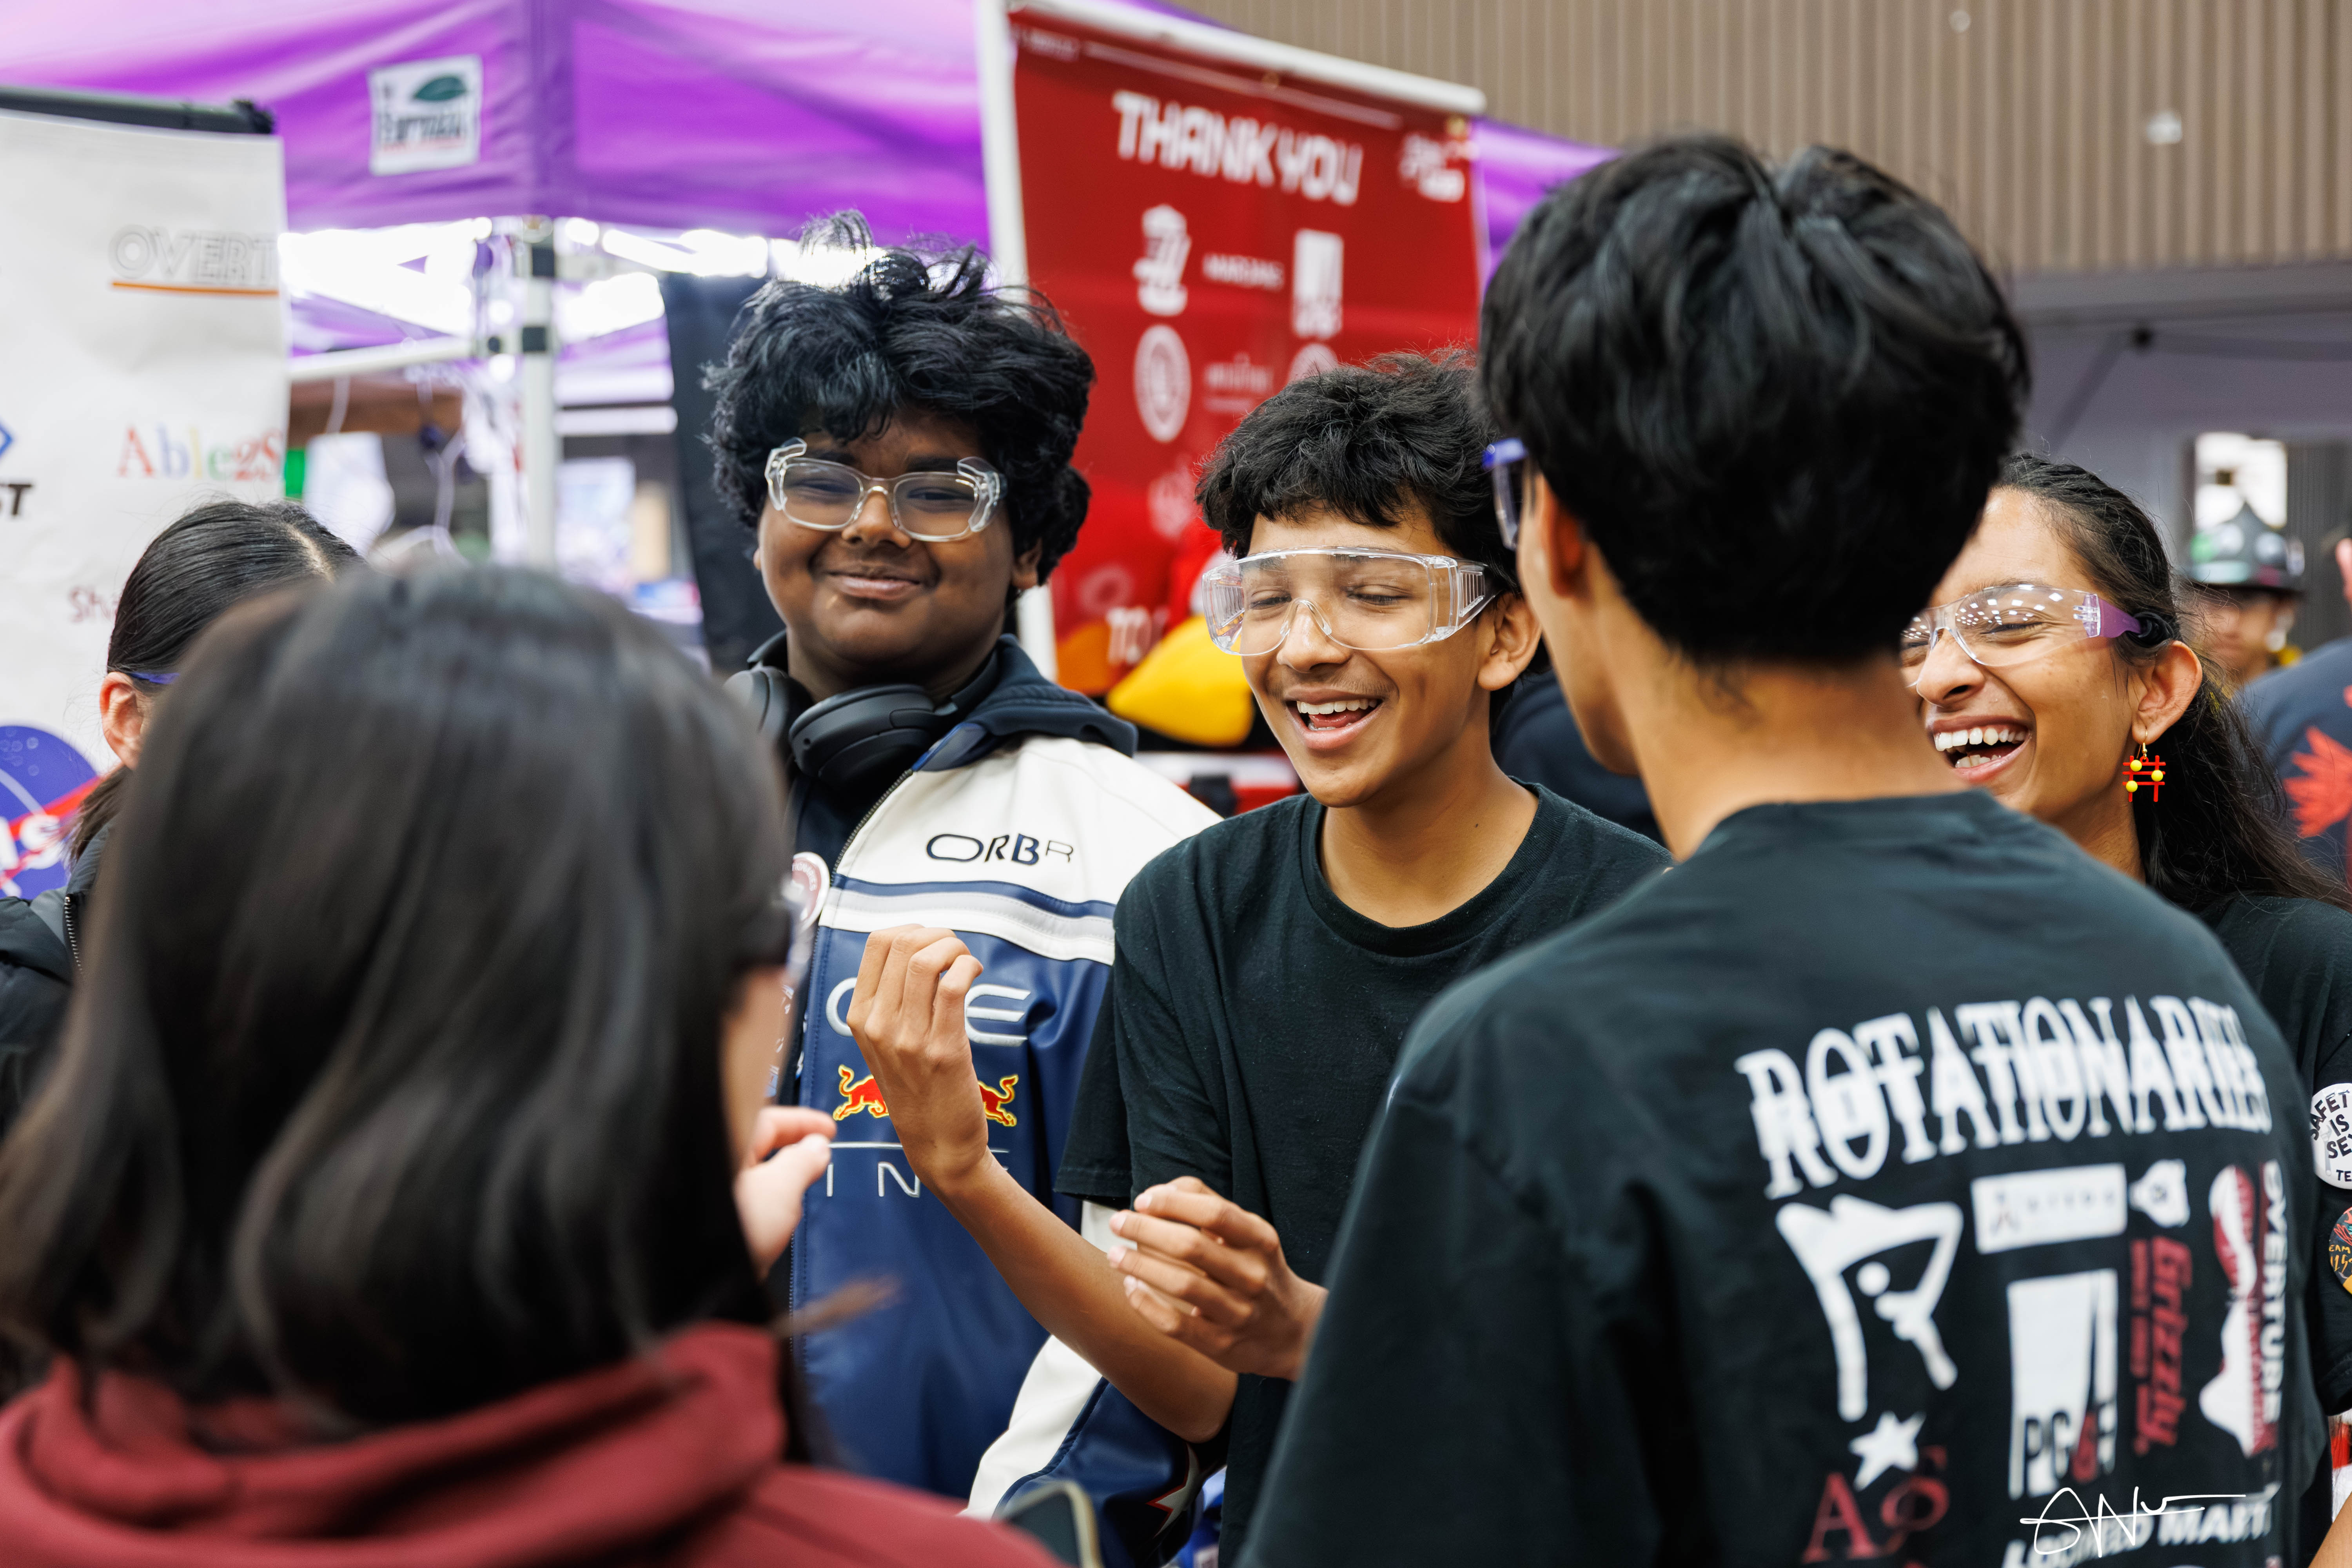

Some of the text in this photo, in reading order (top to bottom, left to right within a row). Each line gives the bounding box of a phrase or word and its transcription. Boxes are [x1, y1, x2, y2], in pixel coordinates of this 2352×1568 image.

[1112, 89, 1279, 189] THANK
[1275, 125, 1364, 207] YOU
[926, 833, 1074, 866] ORBR
[1734, 995, 2272, 1200] ROTATIONARIES
[2329, 1114, 2349, 1137] IS
[2327, 1134, 2352, 1159] SE
